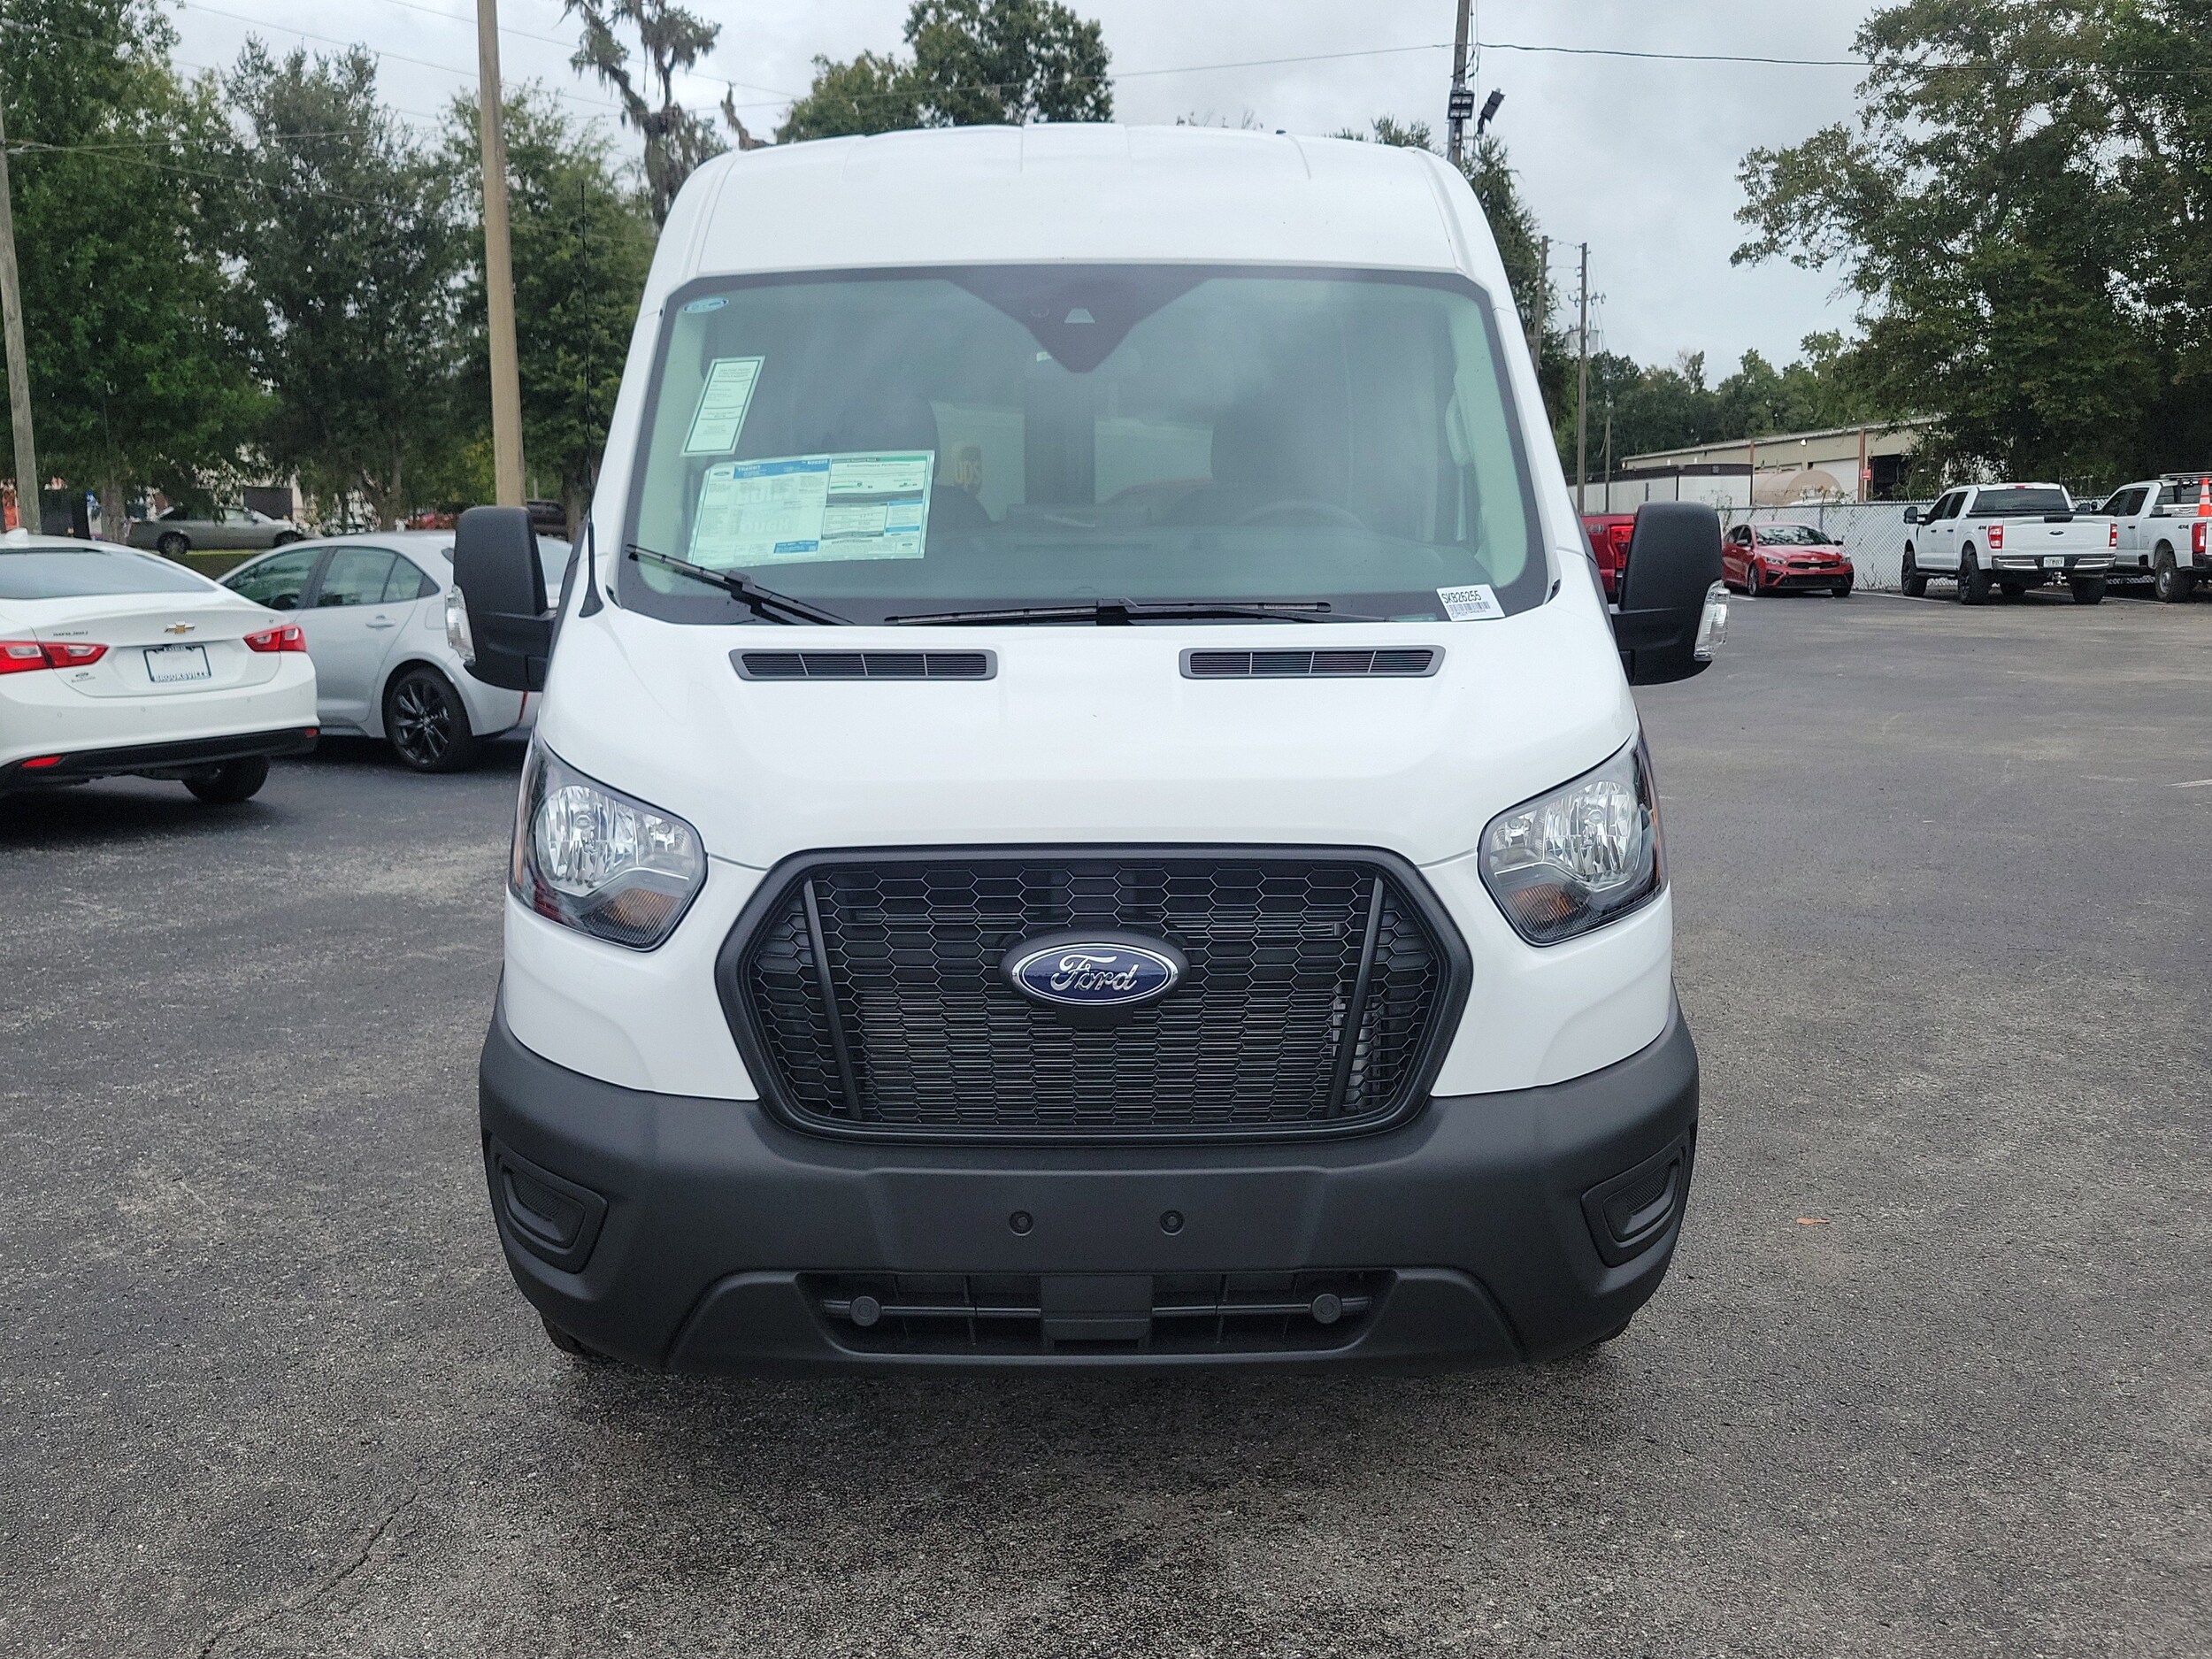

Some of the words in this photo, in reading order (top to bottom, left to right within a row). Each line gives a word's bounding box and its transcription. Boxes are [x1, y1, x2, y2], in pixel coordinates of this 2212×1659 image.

[1441, 590, 1482, 603] SKB26255
[153, 672, 209, 682] BROOKSVILLE
[1050, 954, 1140, 991] Ford
